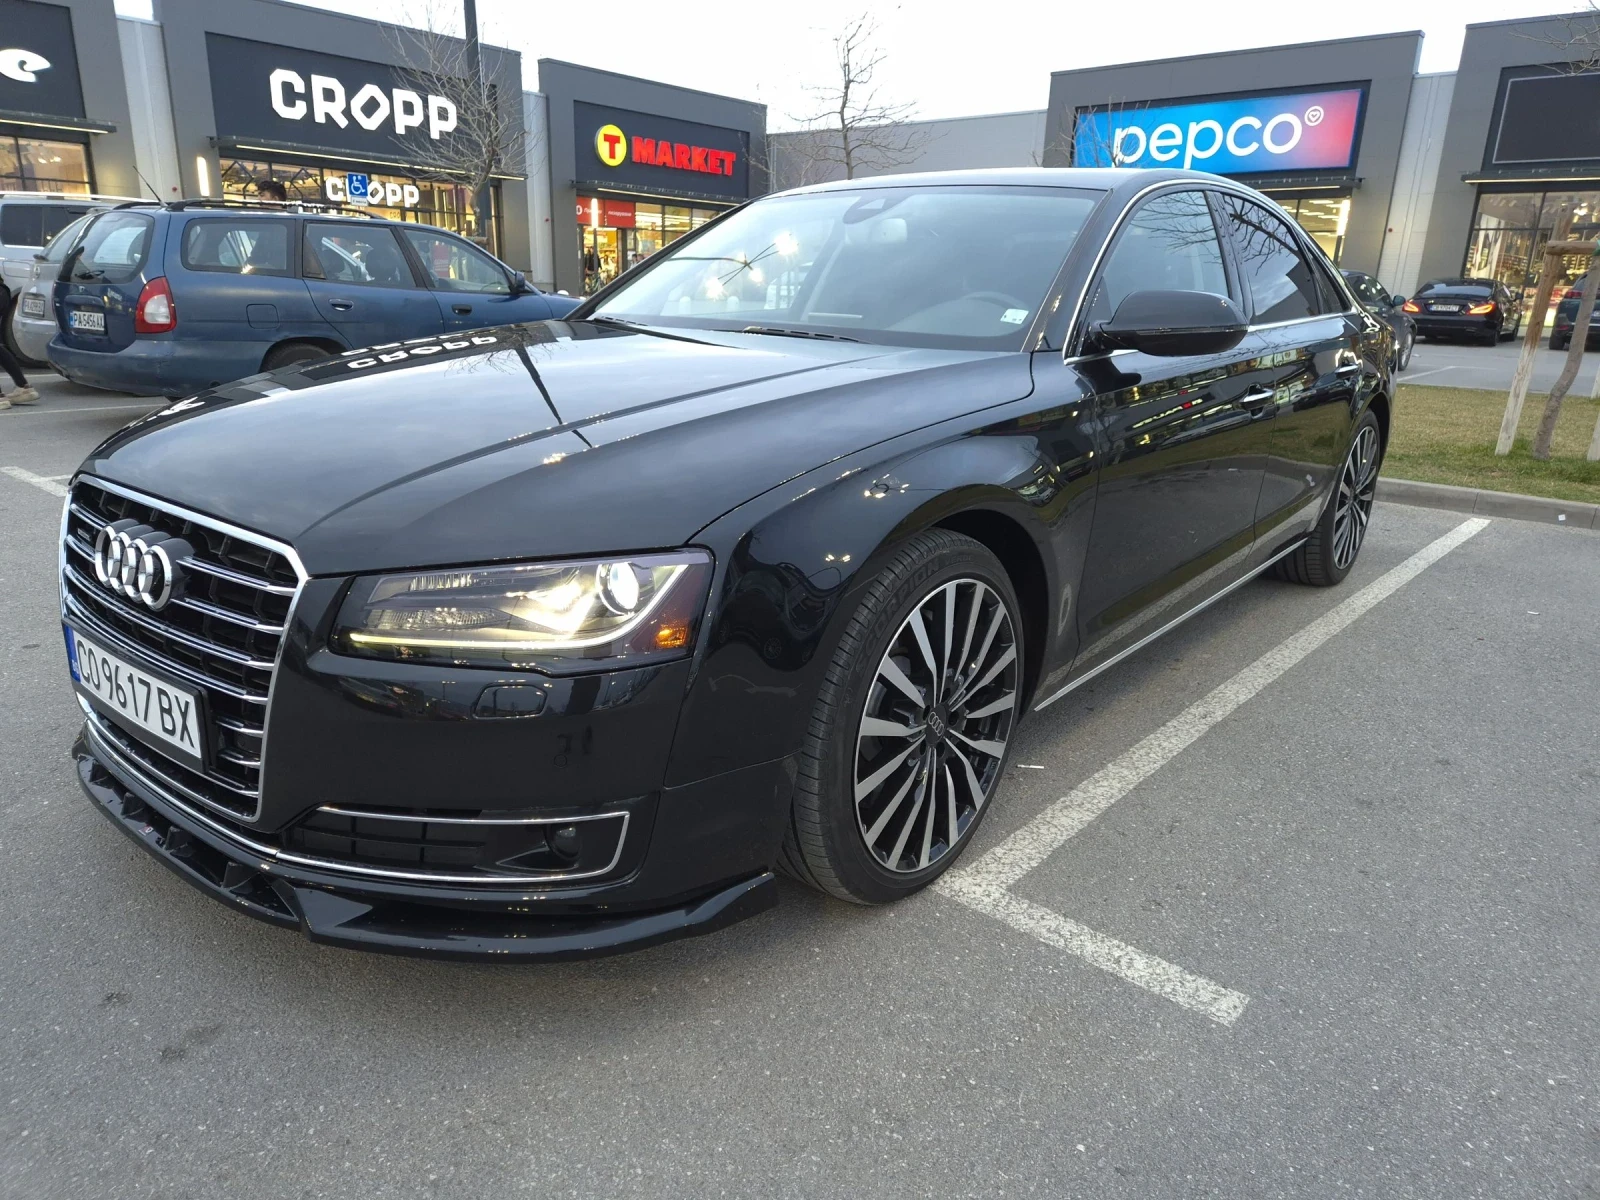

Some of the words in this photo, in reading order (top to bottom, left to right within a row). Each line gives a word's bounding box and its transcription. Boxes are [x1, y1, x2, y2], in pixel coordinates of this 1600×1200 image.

[269, 68, 457, 140] CROPP
[603, 133, 621, 160] T
[631, 136, 737, 176] MARKET
[1112, 112, 1303, 170] pepco
